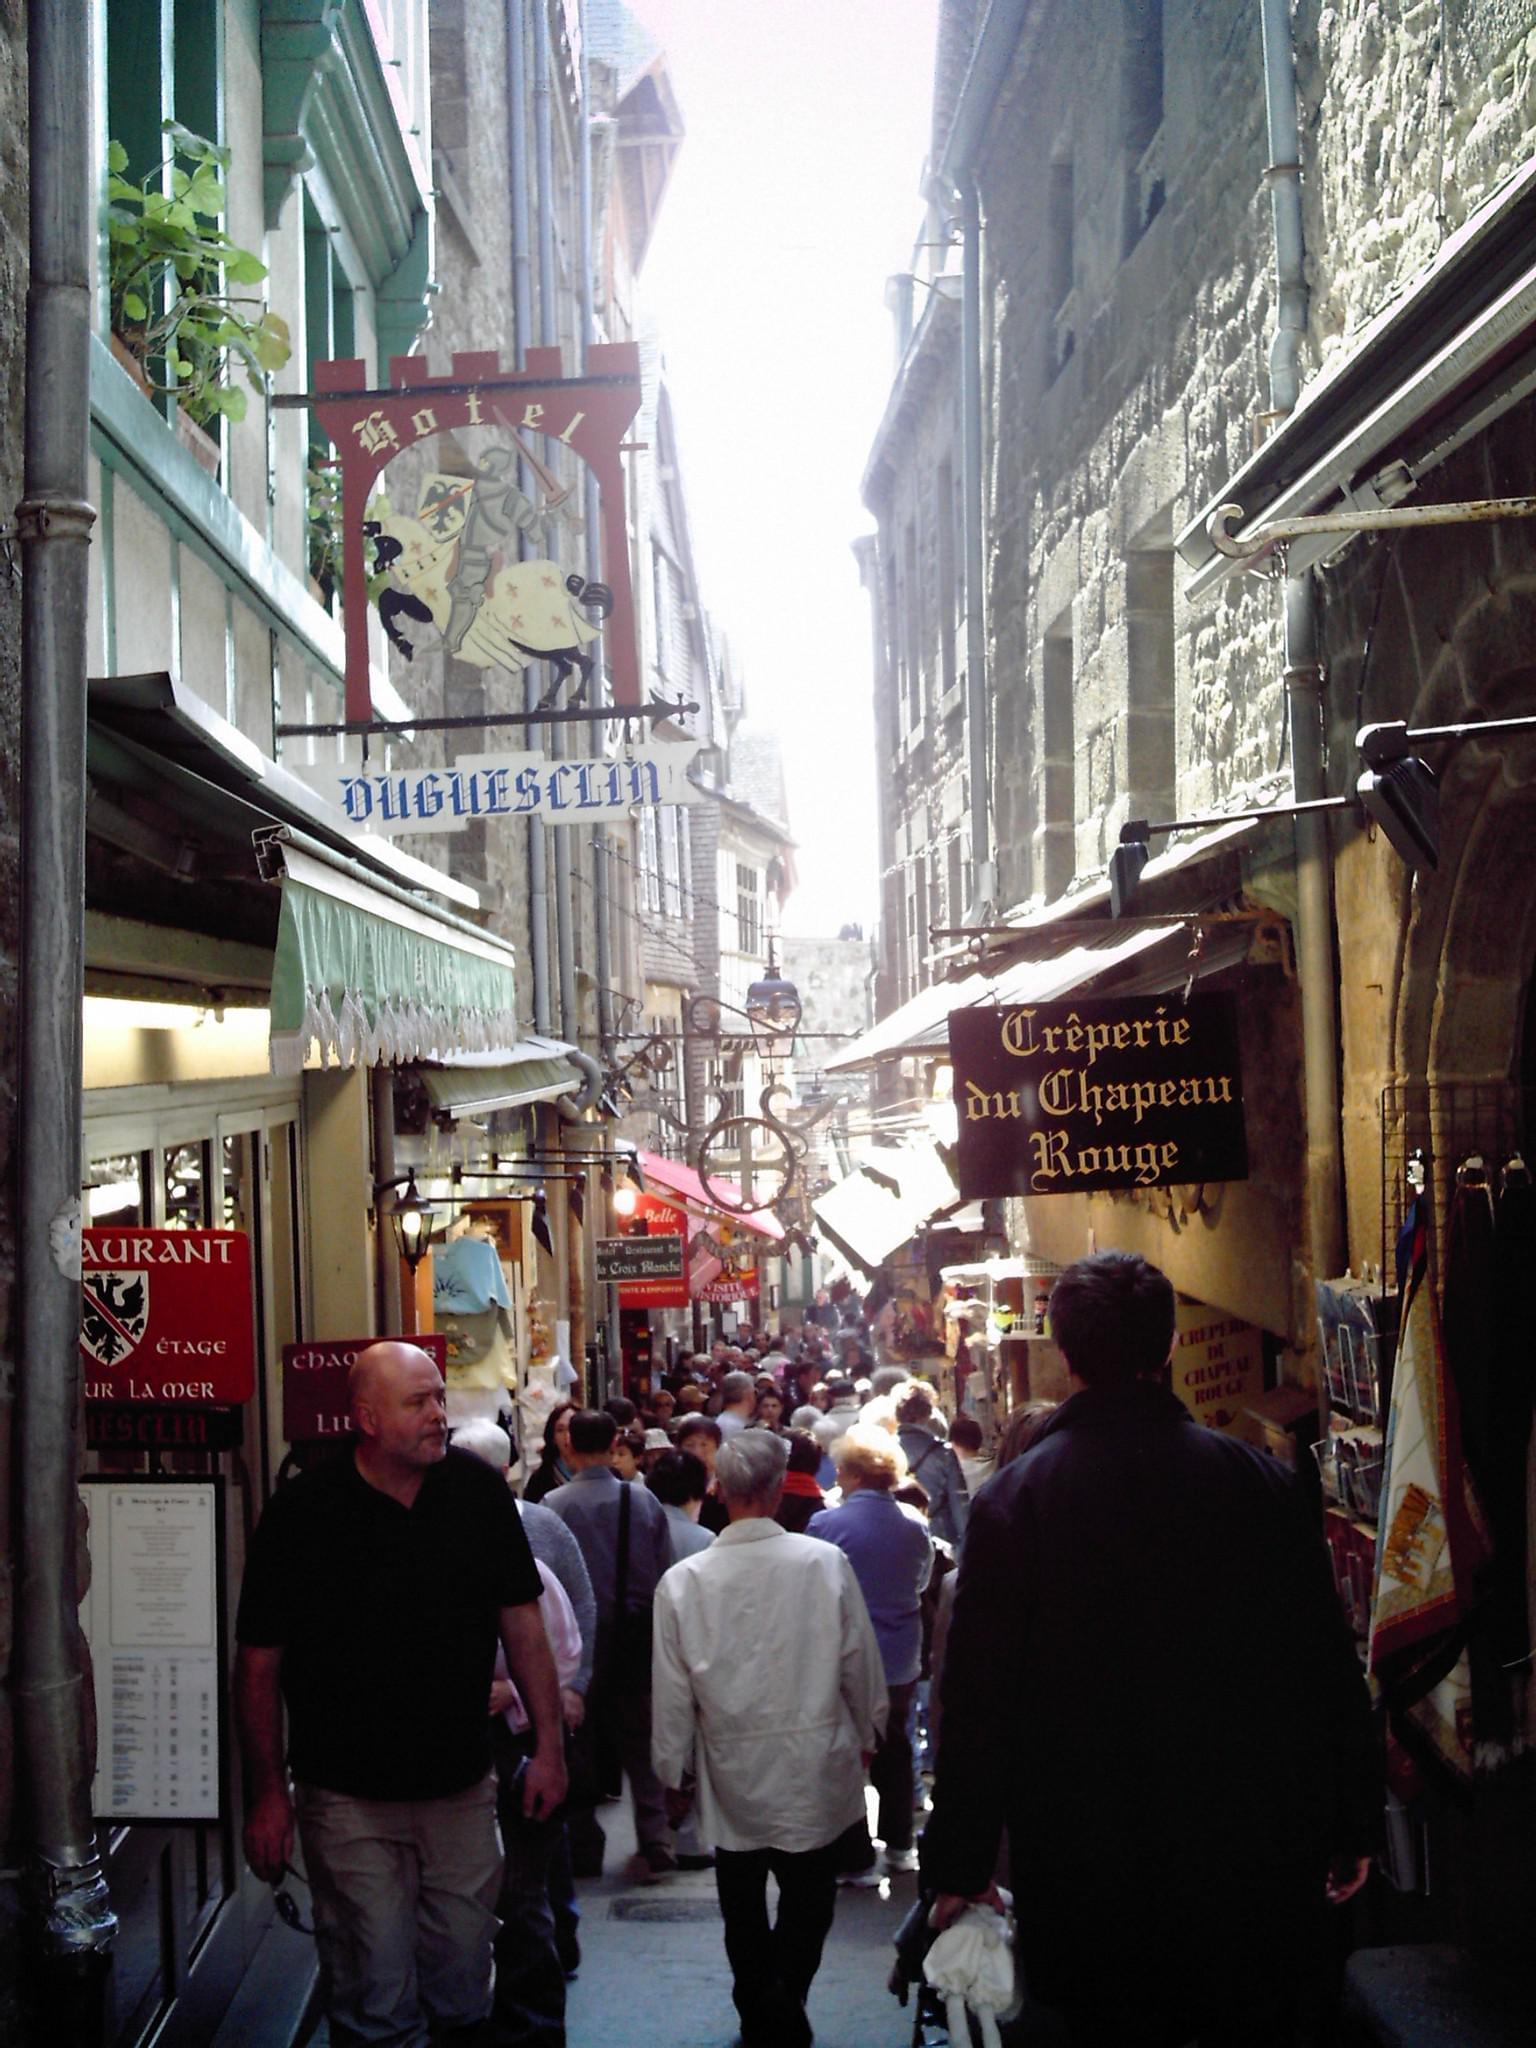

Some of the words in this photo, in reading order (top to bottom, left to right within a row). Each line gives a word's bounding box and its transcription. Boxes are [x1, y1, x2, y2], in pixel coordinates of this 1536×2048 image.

[352, 393, 585, 456] Hotel
[338, 760, 662, 823] DUGUESCLIN
[1001, 1007, 1191, 1065] Crêperie
[965, 1080, 1020, 1121] du
[1038, 1068, 1232, 1126] Chapeau
[1028, 1131, 1179, 1192] Rouge
[645, 1207, 677, 1223] Belle
[609, 1261, 638, 1275] Croix
[641, 1259, 681, 1274] Blanche
[156, 1336, 227, 1357] ÉTAGE
[162, 1381, 216, 1399] MER
